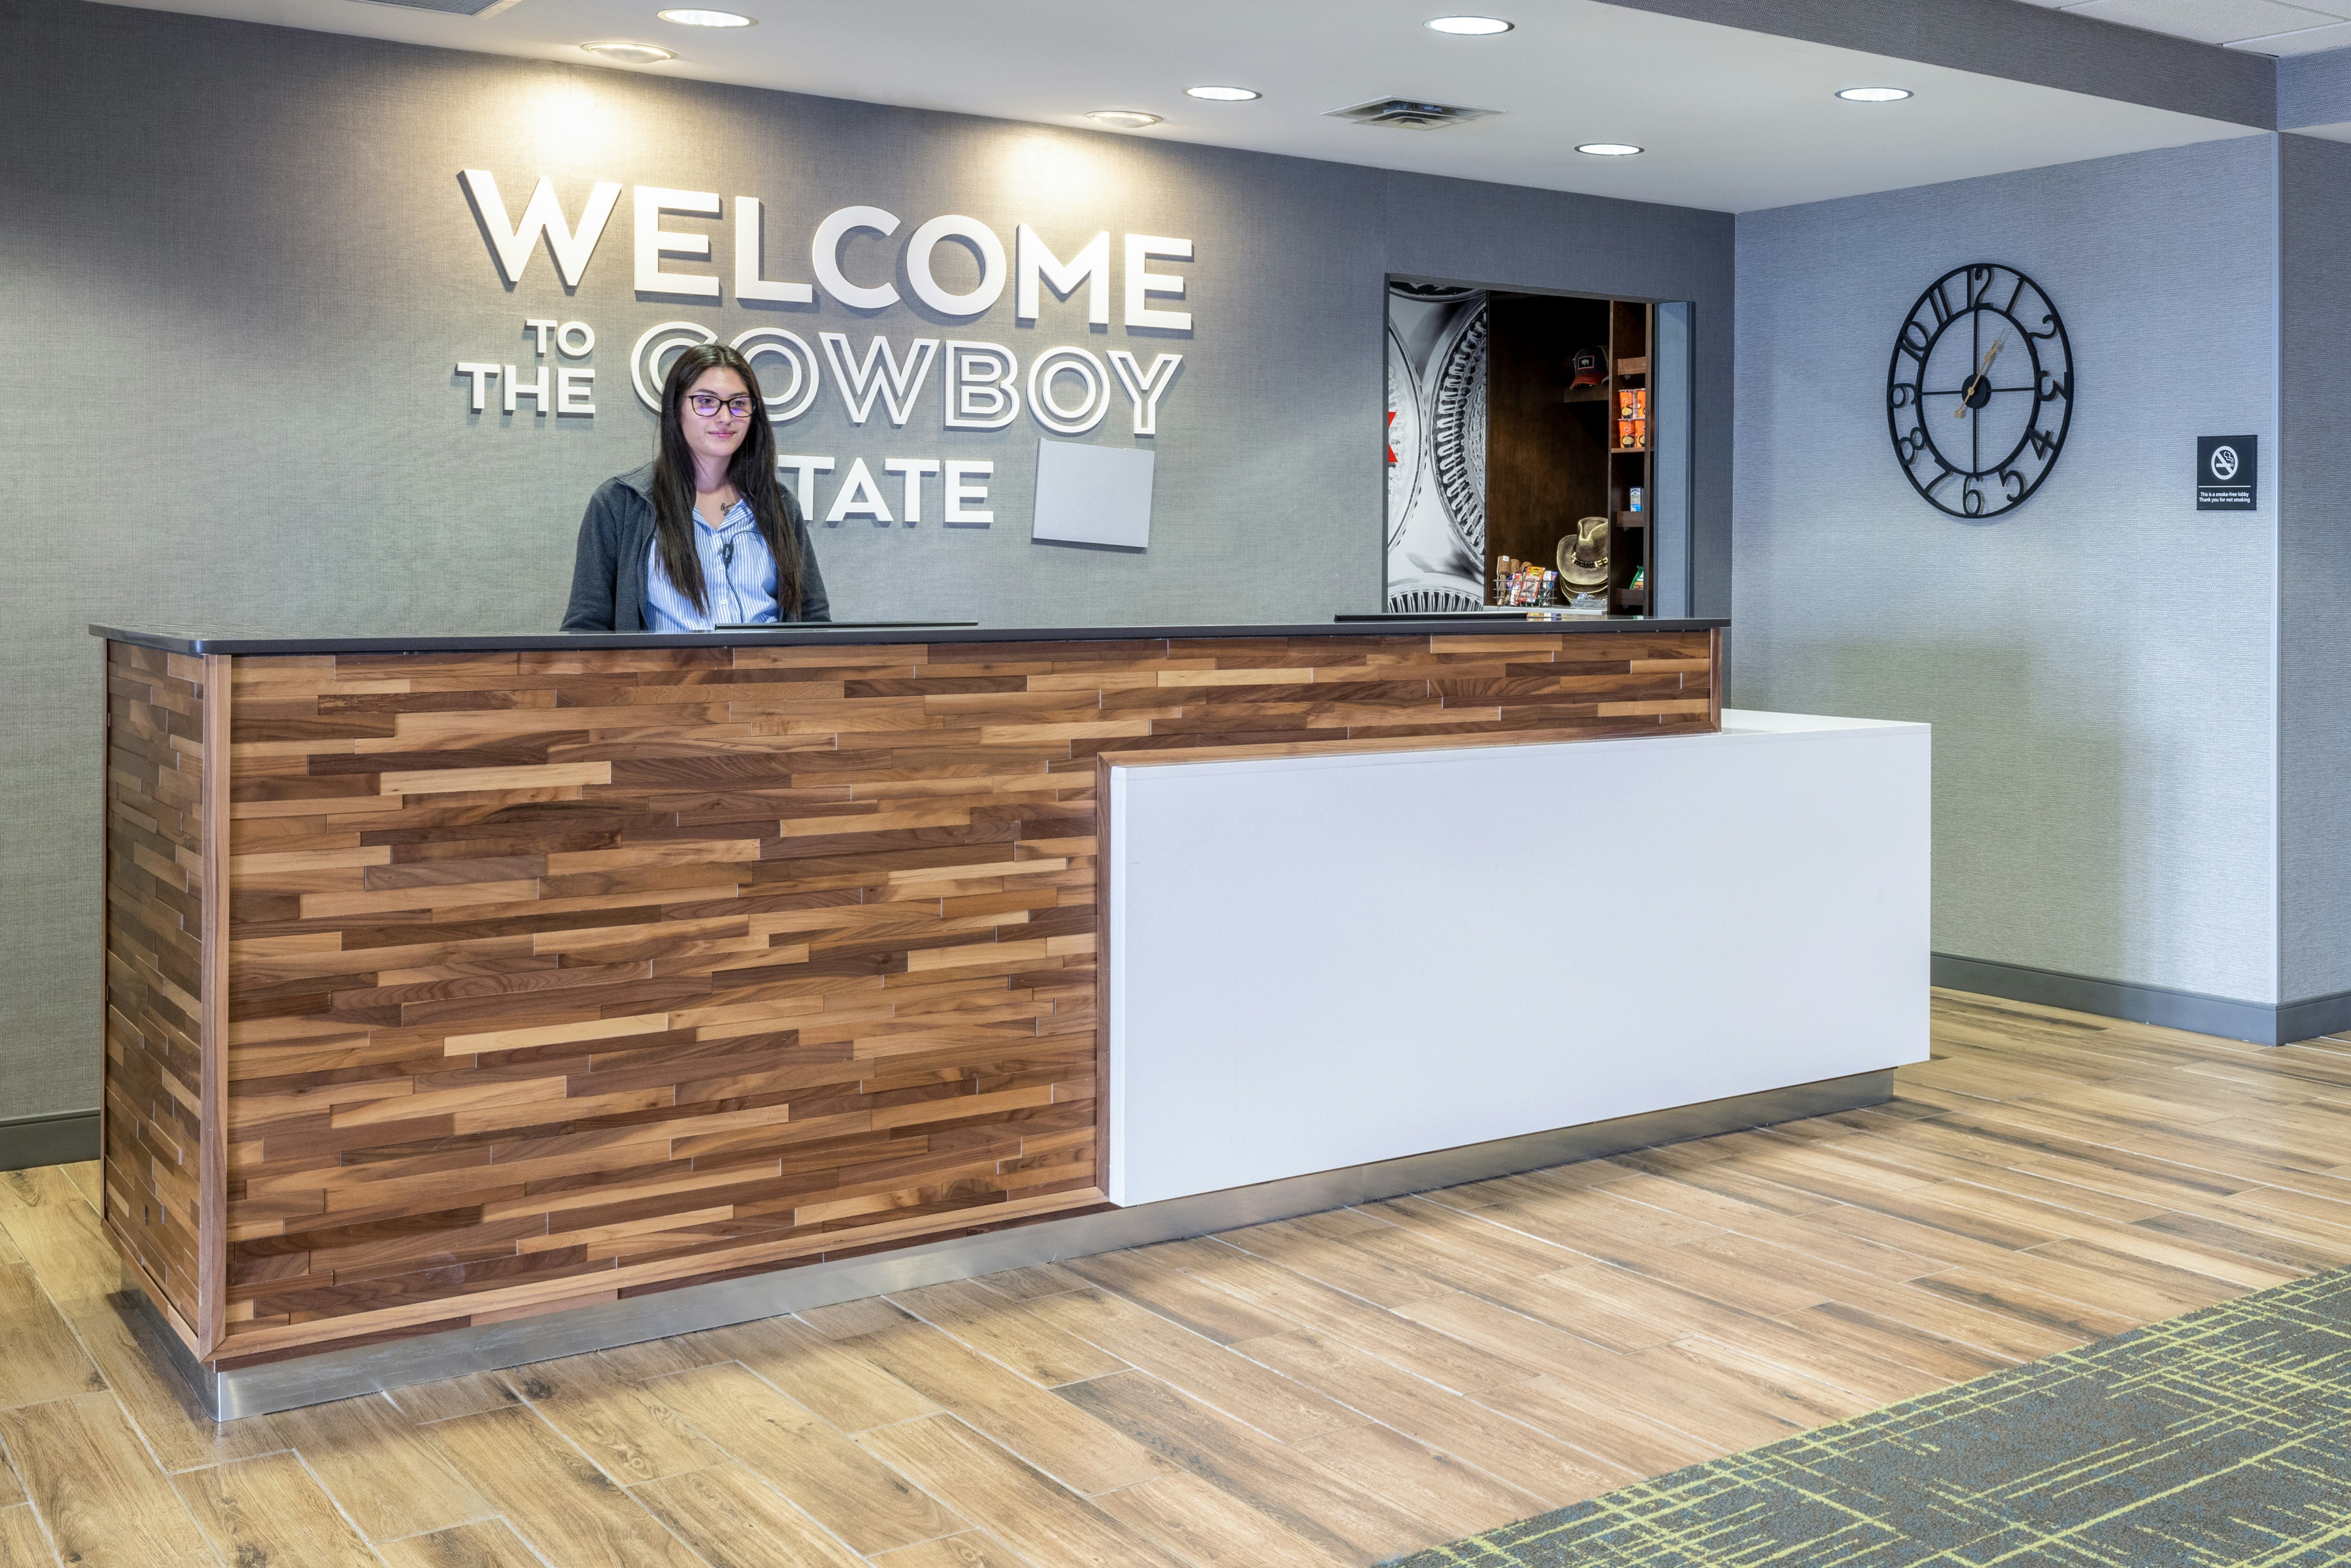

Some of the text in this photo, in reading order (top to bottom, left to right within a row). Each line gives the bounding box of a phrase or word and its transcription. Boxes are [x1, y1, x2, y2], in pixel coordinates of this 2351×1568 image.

[459, 169, 1192, 330] WELCOME
[1967, 268, 1992, 308] 12
[526, 319, 595, 356] TO
[2026, 314, 2058, 354] 2
[456, 362, 596, 413] THE
[630, 321, 1183, 435] COWBOY
[1888, 383, 1917, 409] 9
[2035, 370, 2071, 402] 3
[1897, 427, 1926, 465] 8
[2027, 426, 2057, 460] 4
[777, 454, 994, 523] TATE
[1963, 473, 1981, 516] 6
[1998, 456, 2024, 502] 5
